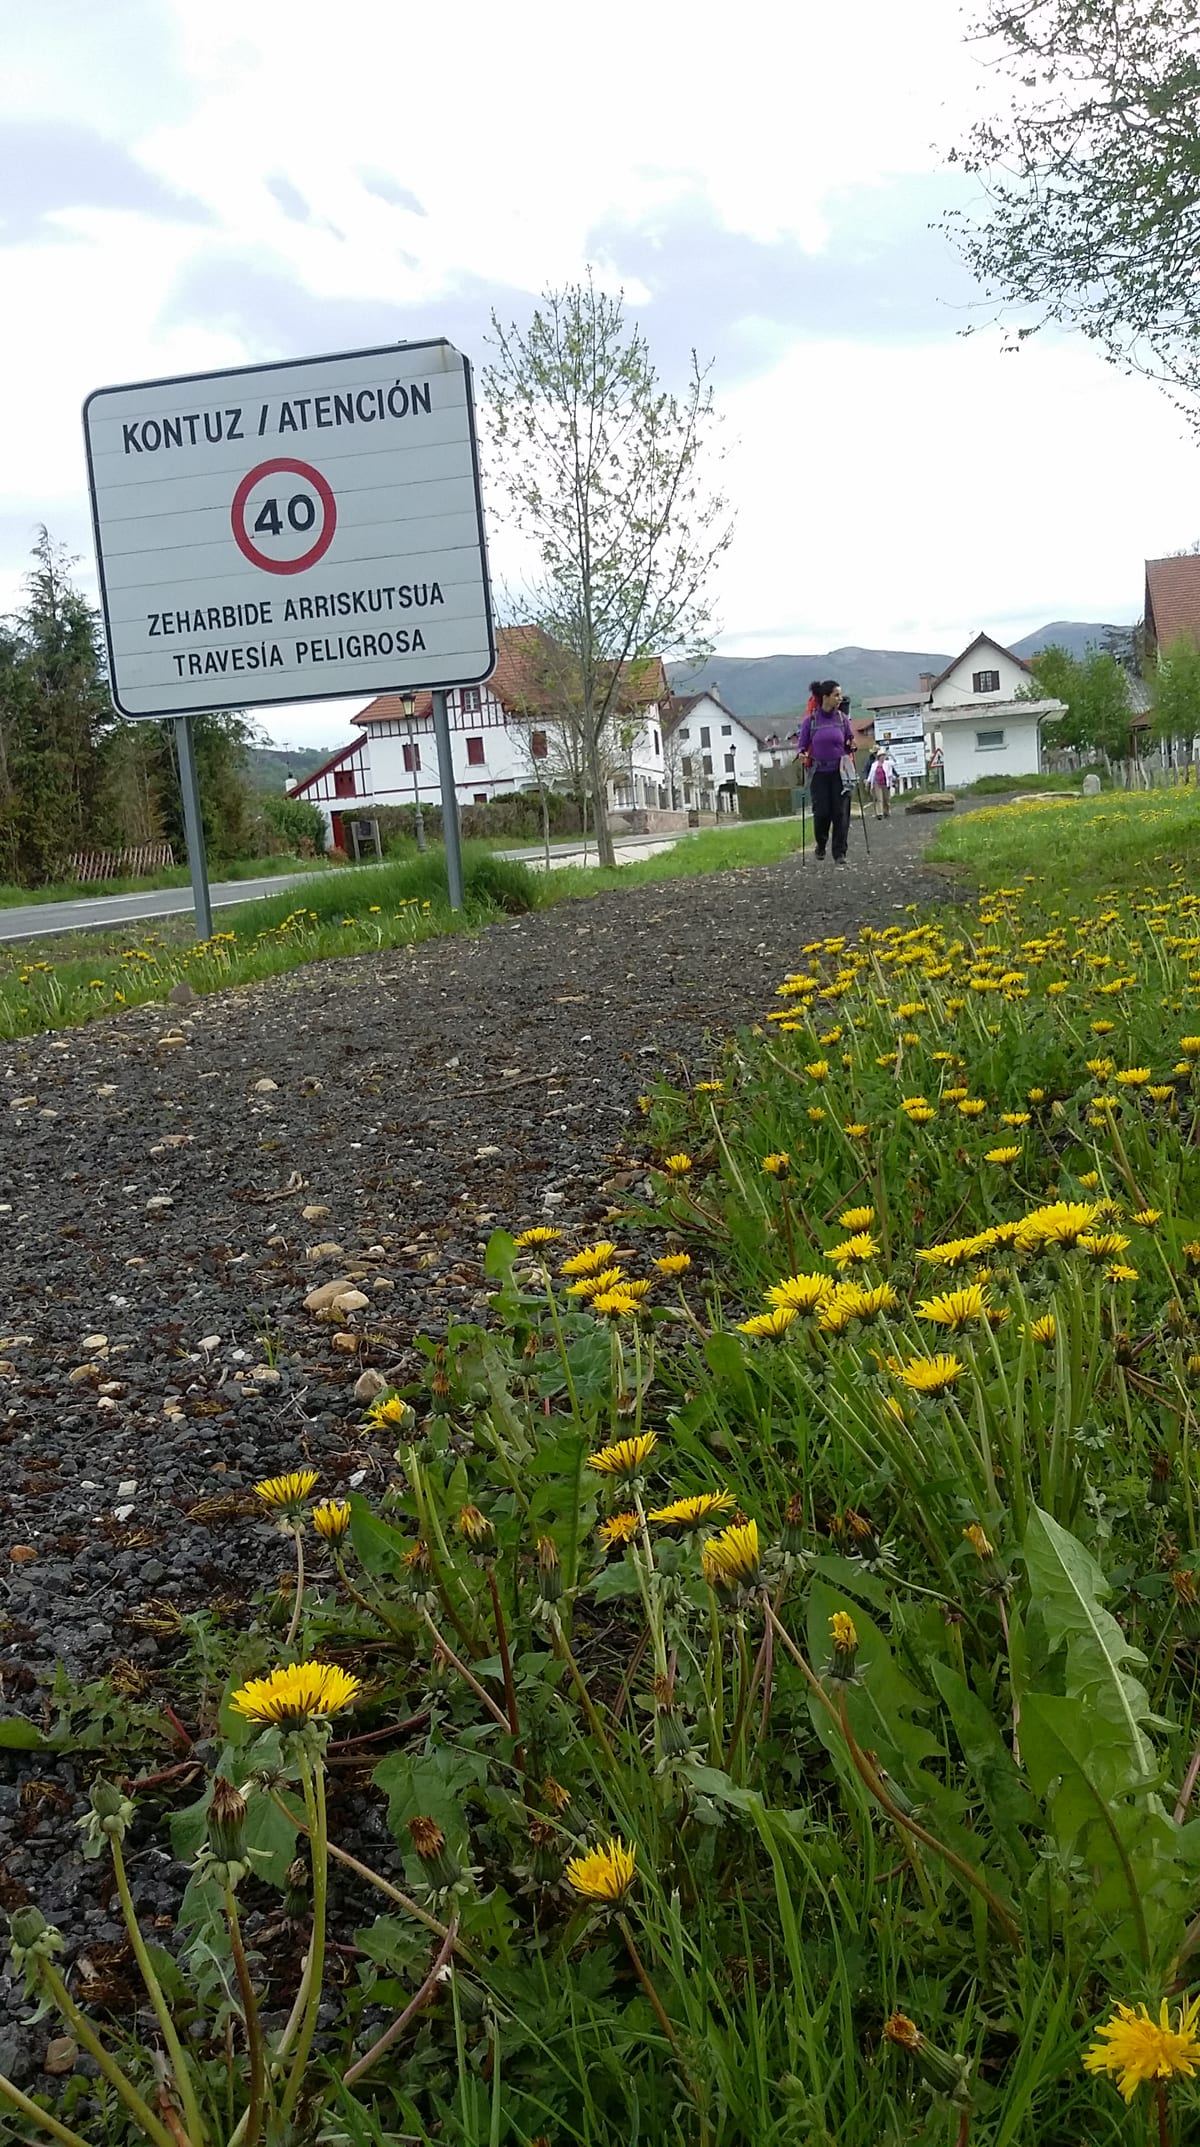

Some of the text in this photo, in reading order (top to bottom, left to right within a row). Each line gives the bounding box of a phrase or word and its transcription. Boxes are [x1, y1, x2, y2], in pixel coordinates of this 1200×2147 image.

[123, 409, 244, 454] KONTUZ
[278, 380, 432, 433] ATENCIÓN
[254, 494, 315, 536] 40
[148, 582, 444, 637] ZEHARBIDE ARRISKUTSUA
[174, 629, 426, 677] TRAVESÍA PELIGROSA
